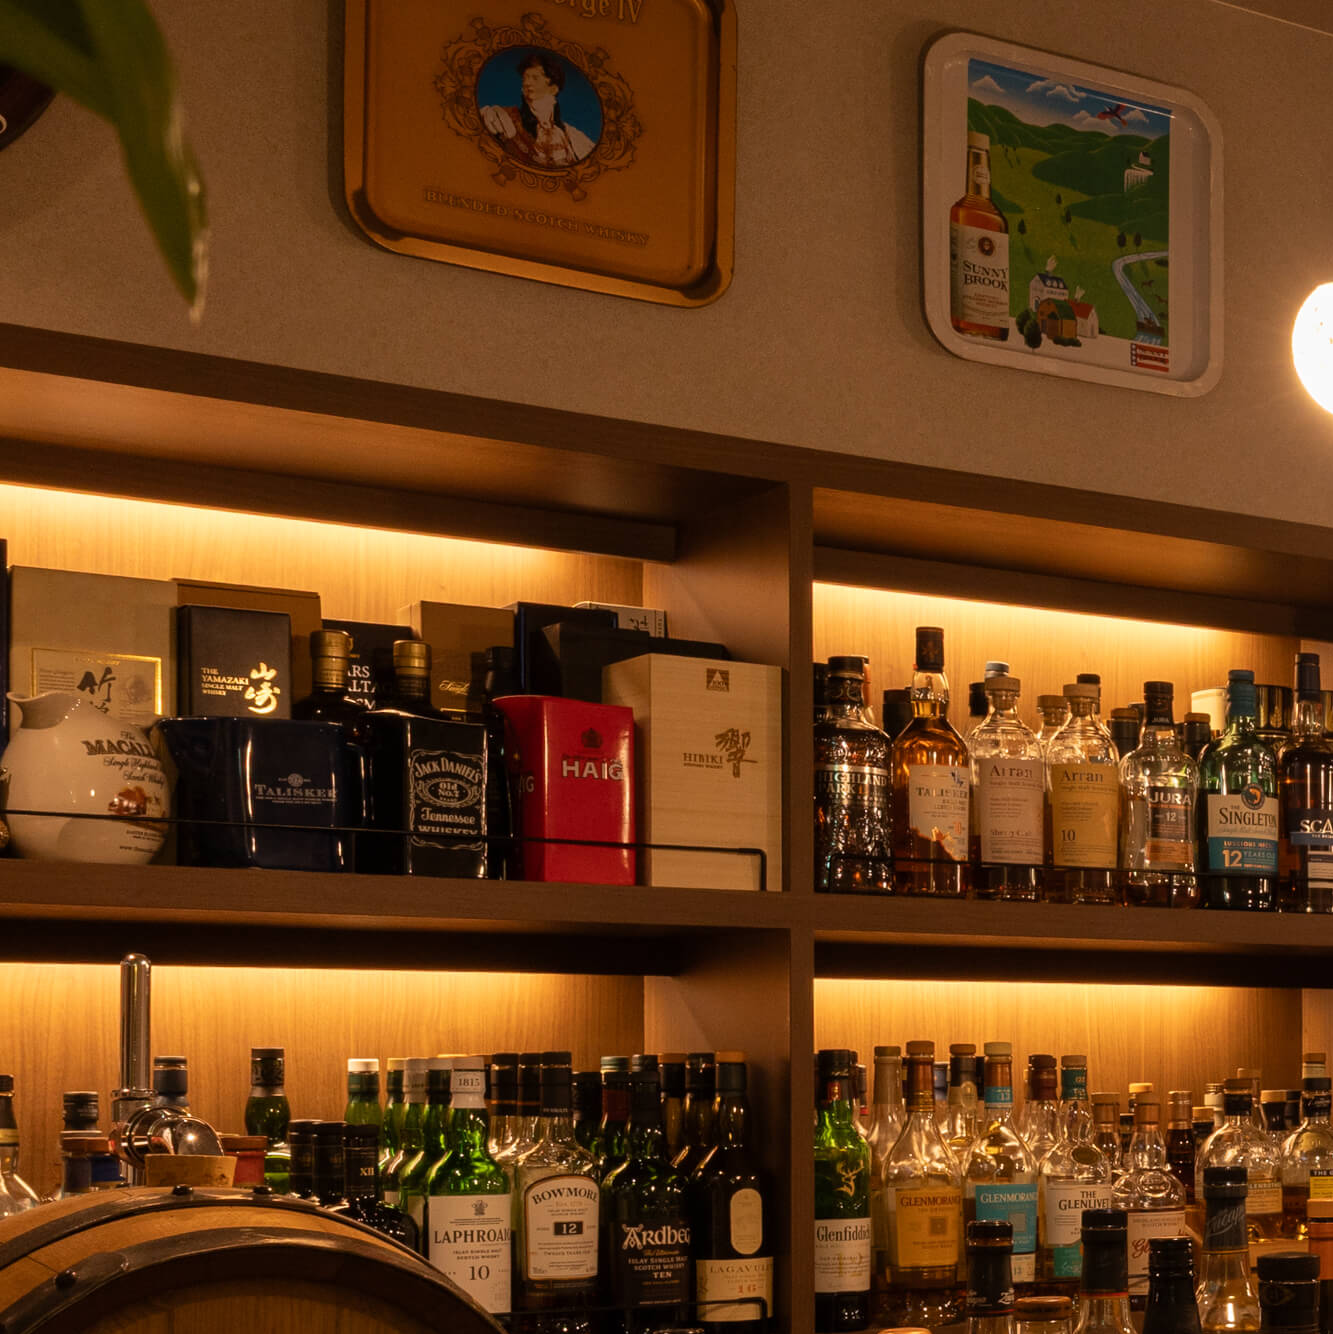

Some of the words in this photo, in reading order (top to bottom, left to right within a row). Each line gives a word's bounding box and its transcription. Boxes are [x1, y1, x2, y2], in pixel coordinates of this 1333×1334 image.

[511, 207, 580, 233] SCOTCH
[583, 221, 651, 246] WHISKY
[962, 259, 1008, 280] SUNNY
[964, 273, 1008, 292] BROOK
[201, 667, 219, 676] THE
[201, 675, 249, 686] YAMAZAKI
[244, 662, 281, 715] 山崎
[683, 752, 724, 764] HIBIKI
[715, 727, 759, 778] 響
[415, 760, 441, 778] JACK
[562, 759, 624, 780] HAIG
[990, 765, 1033, 778] Arran
[1062, 769, 1103, 782] Arran
[818, 771, 888, 786] HIGHLAND
[254, 783, 338, 799] TALISKER
[818, 782, 856, 795] PARK
[1150, 791, 1192, 806] JURA
[420, 807, 476, 825] Tennessee
[1165, 811, 1177, 822] 12
[1060, 829, 1076, 841] 10
[1221, 848, 1243, 868] 12
[457, 1077, 481, 1088] 1815
[1080, 1190, 1096, 1199] THE
[560, 1222, 578, 1234] 12
[469, 1265, 490, 1281] 10
[652, 1271, 673, 1279] TEN
